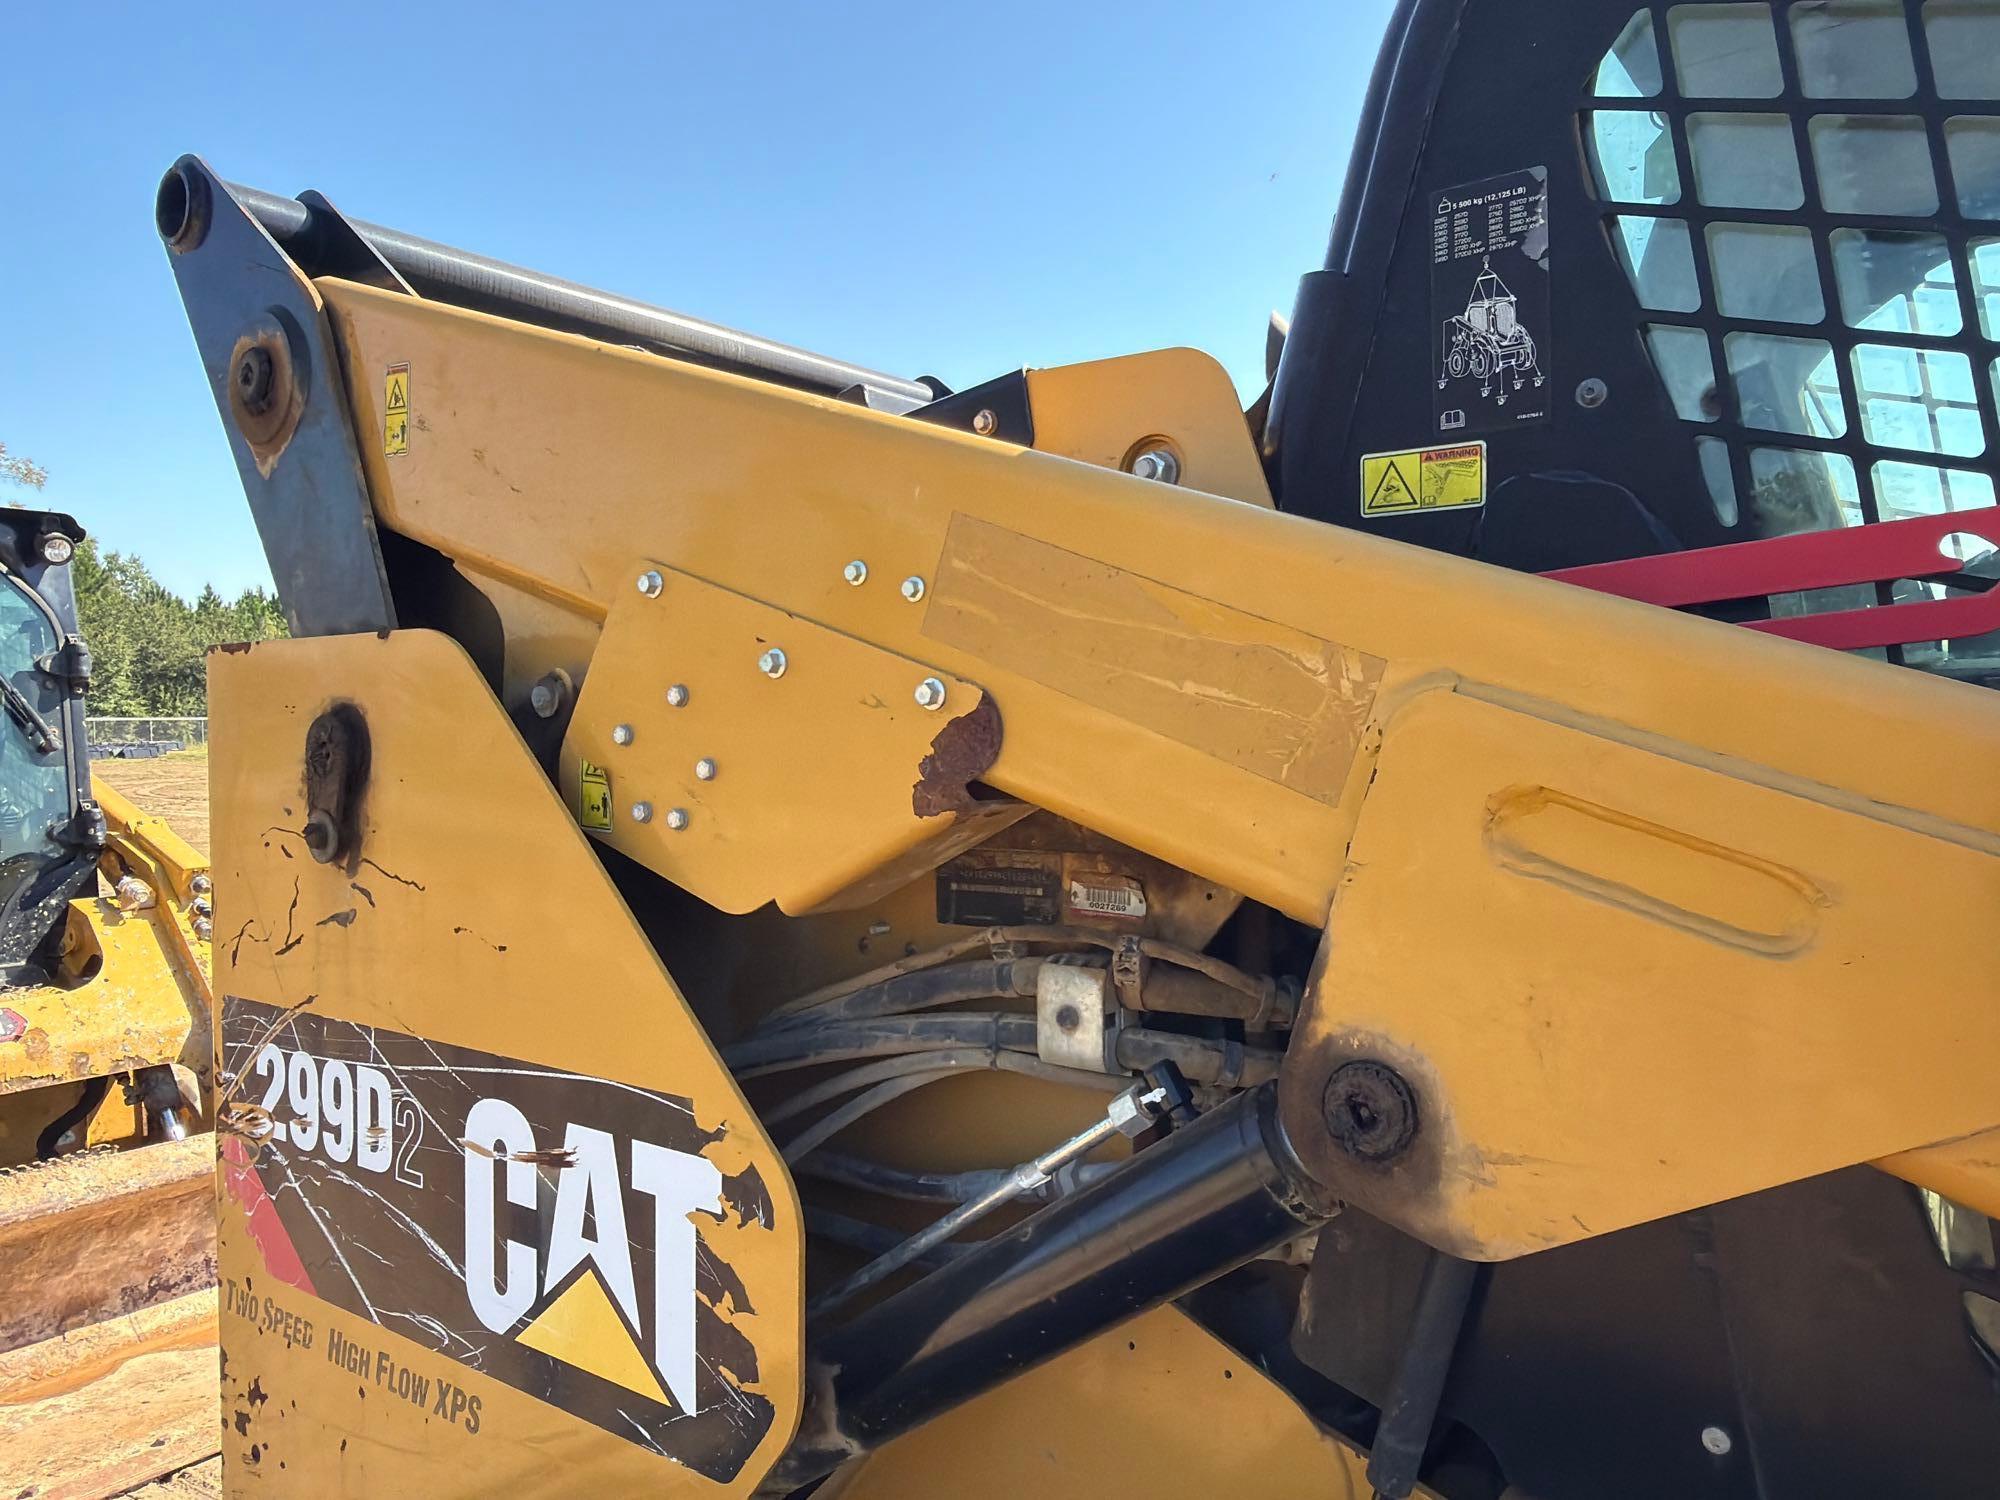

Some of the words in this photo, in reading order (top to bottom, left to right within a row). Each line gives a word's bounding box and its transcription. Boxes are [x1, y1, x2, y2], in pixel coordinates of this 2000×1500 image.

[1513, 186, 1526, 195] LB)
[1435, 449, 1478, 460] WARNING
[464, 1098, 723, 1417] CAT
[433, 1378, 482, 1434] XPS
